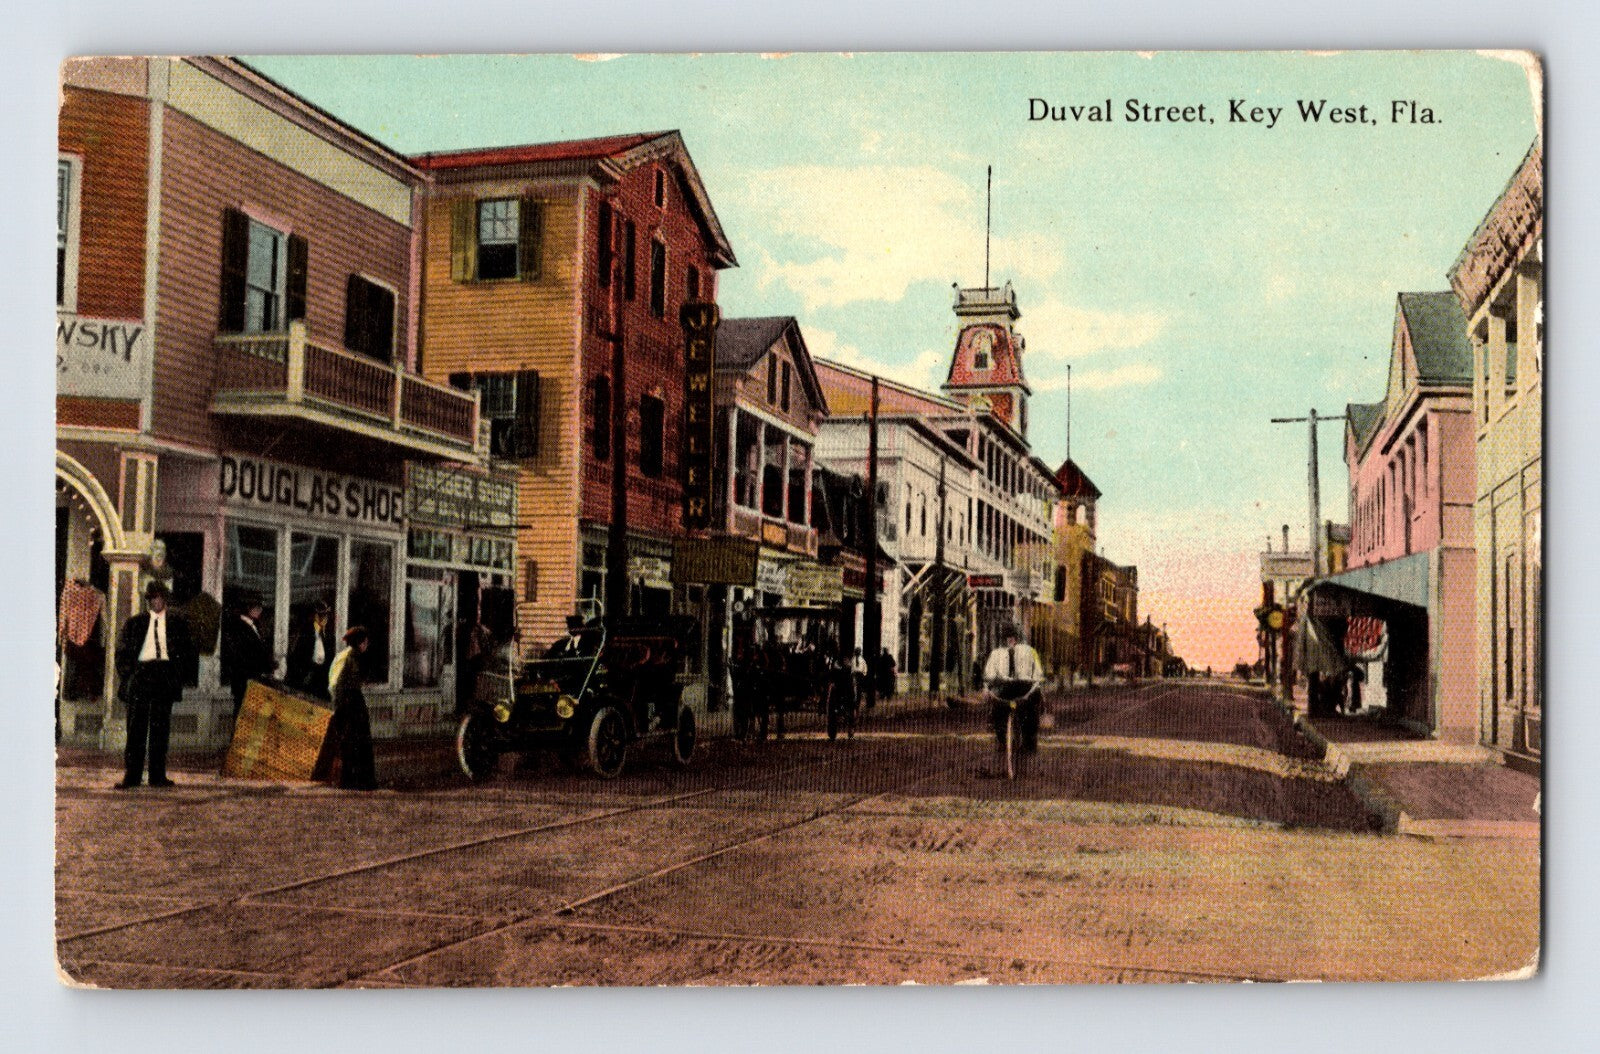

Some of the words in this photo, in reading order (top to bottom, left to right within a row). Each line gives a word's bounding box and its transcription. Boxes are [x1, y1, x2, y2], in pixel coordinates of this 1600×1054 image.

[687, 308, 709, 517] JEWELER
[220, 455, 341, 515] DOUGLAS
[344, 481, 404, 527] SHOE
[410, 465, 474, 500] BARBER
[478, 480, 512, 507] SHOP
